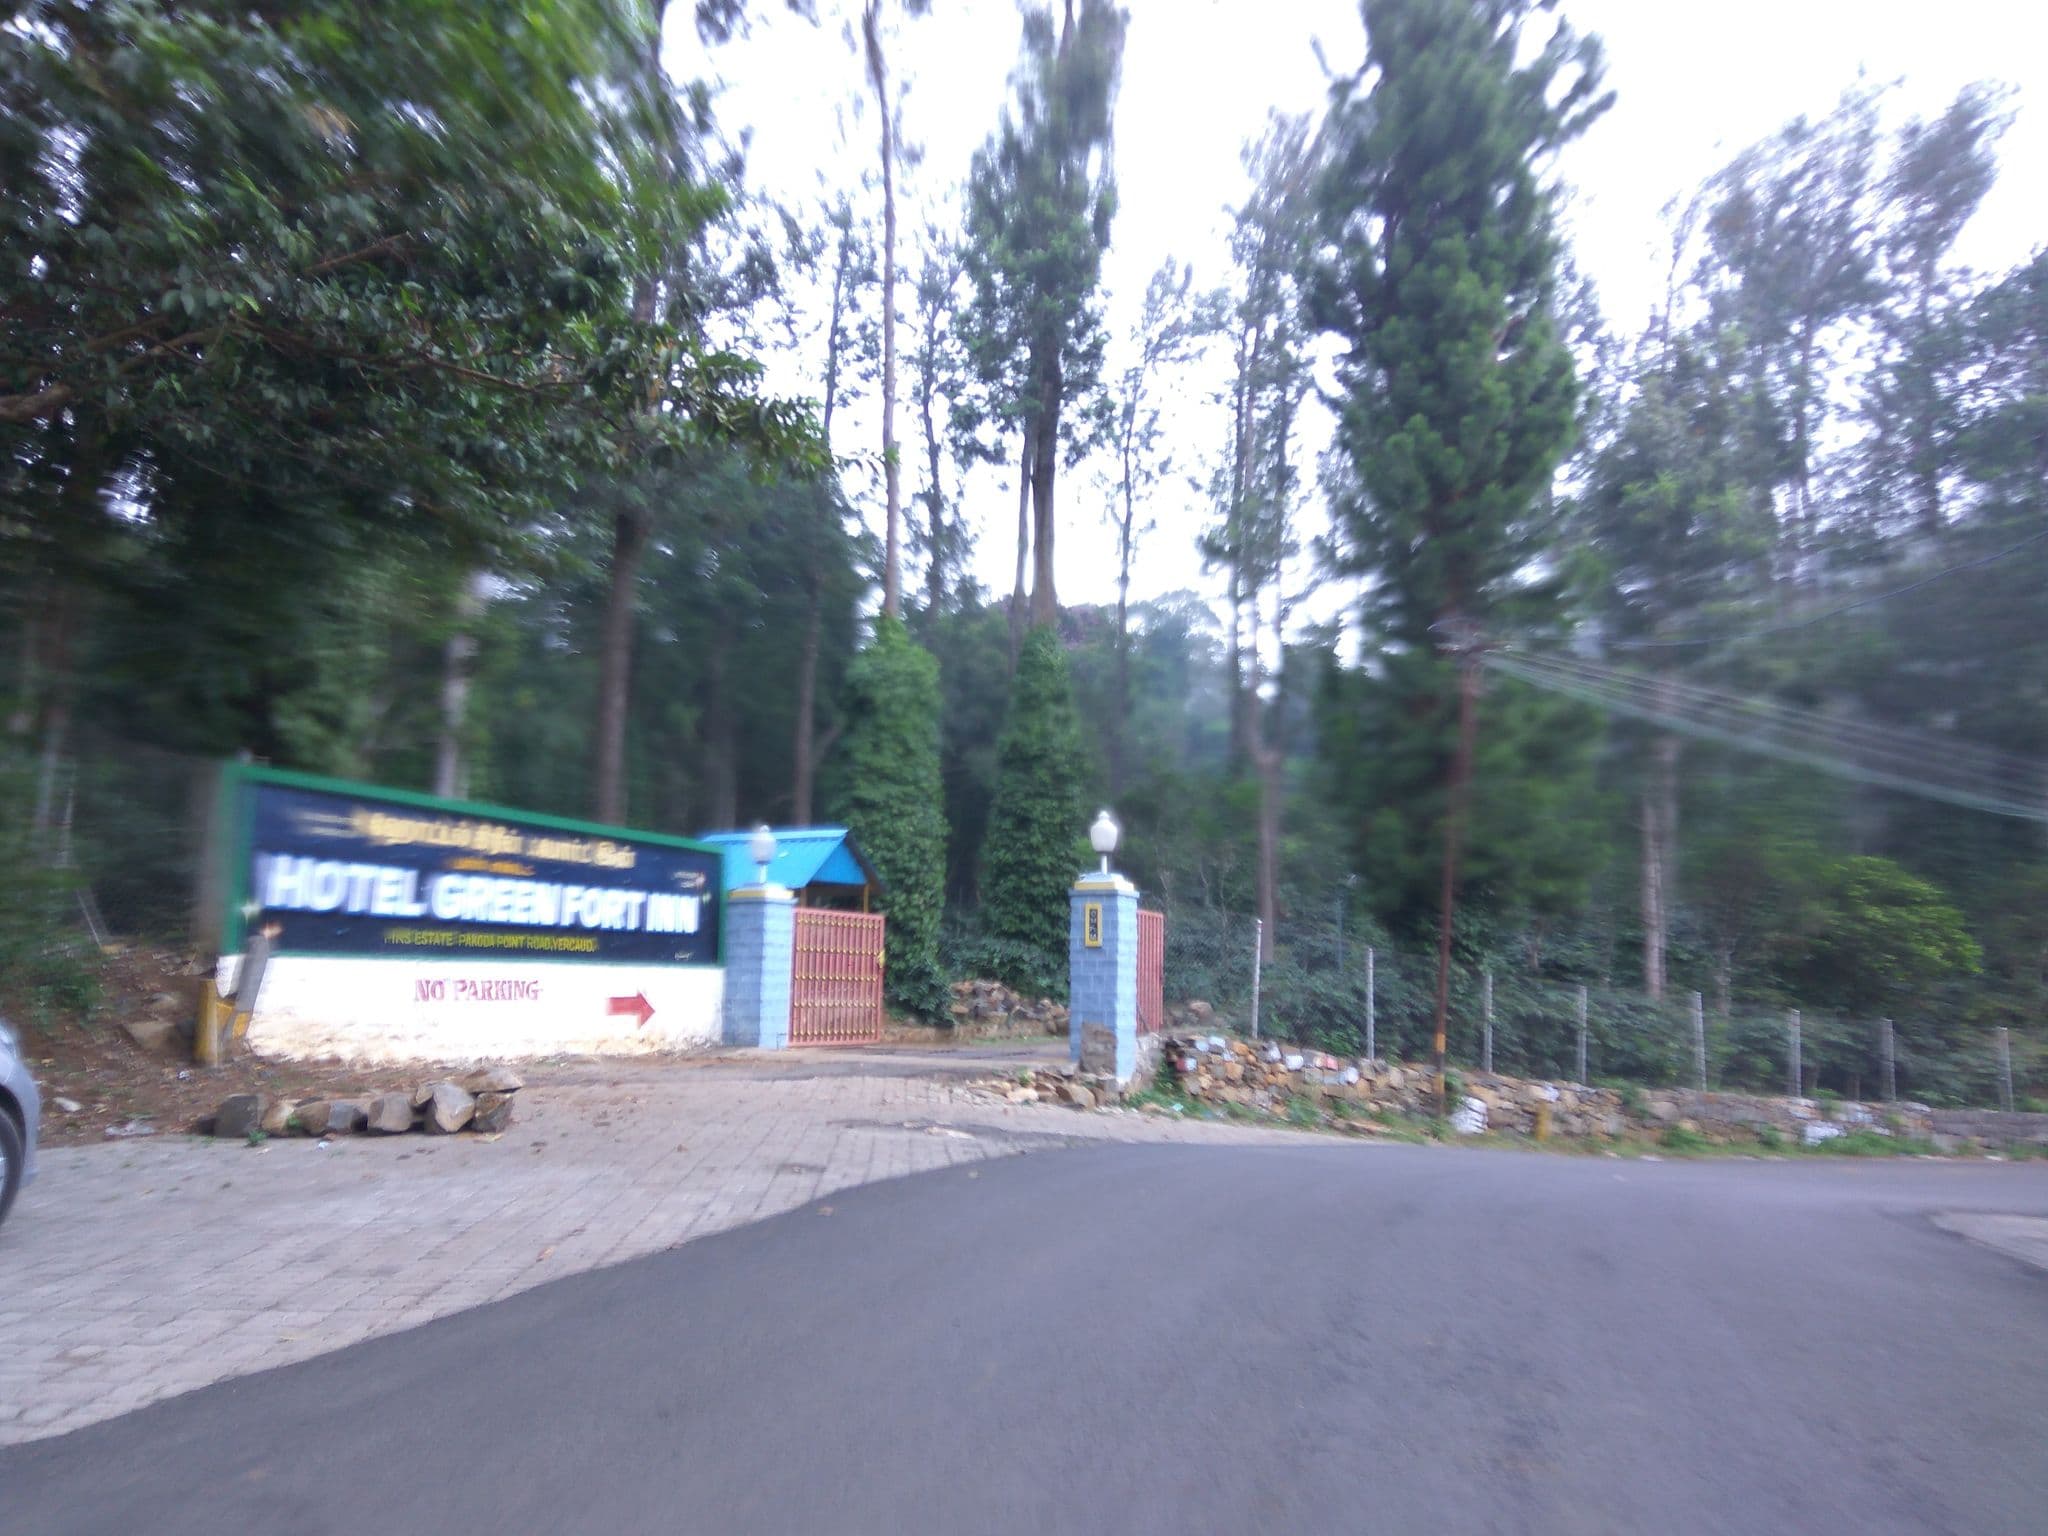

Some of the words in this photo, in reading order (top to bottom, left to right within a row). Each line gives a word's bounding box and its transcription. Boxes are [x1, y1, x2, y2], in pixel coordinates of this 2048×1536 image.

[262, 852, 427, 917] HOTEL
[430, 873, 560, 927] GREEN
[560, 884, 647, 930] FORT
[646, 892, 699, 934] INN
[414, 929, 453, 947] ESTATE
[496, 933, 525, 949] POINT
[414, 978, 446, 1002] NO
[453, 978, 540, 1002] PARKING
